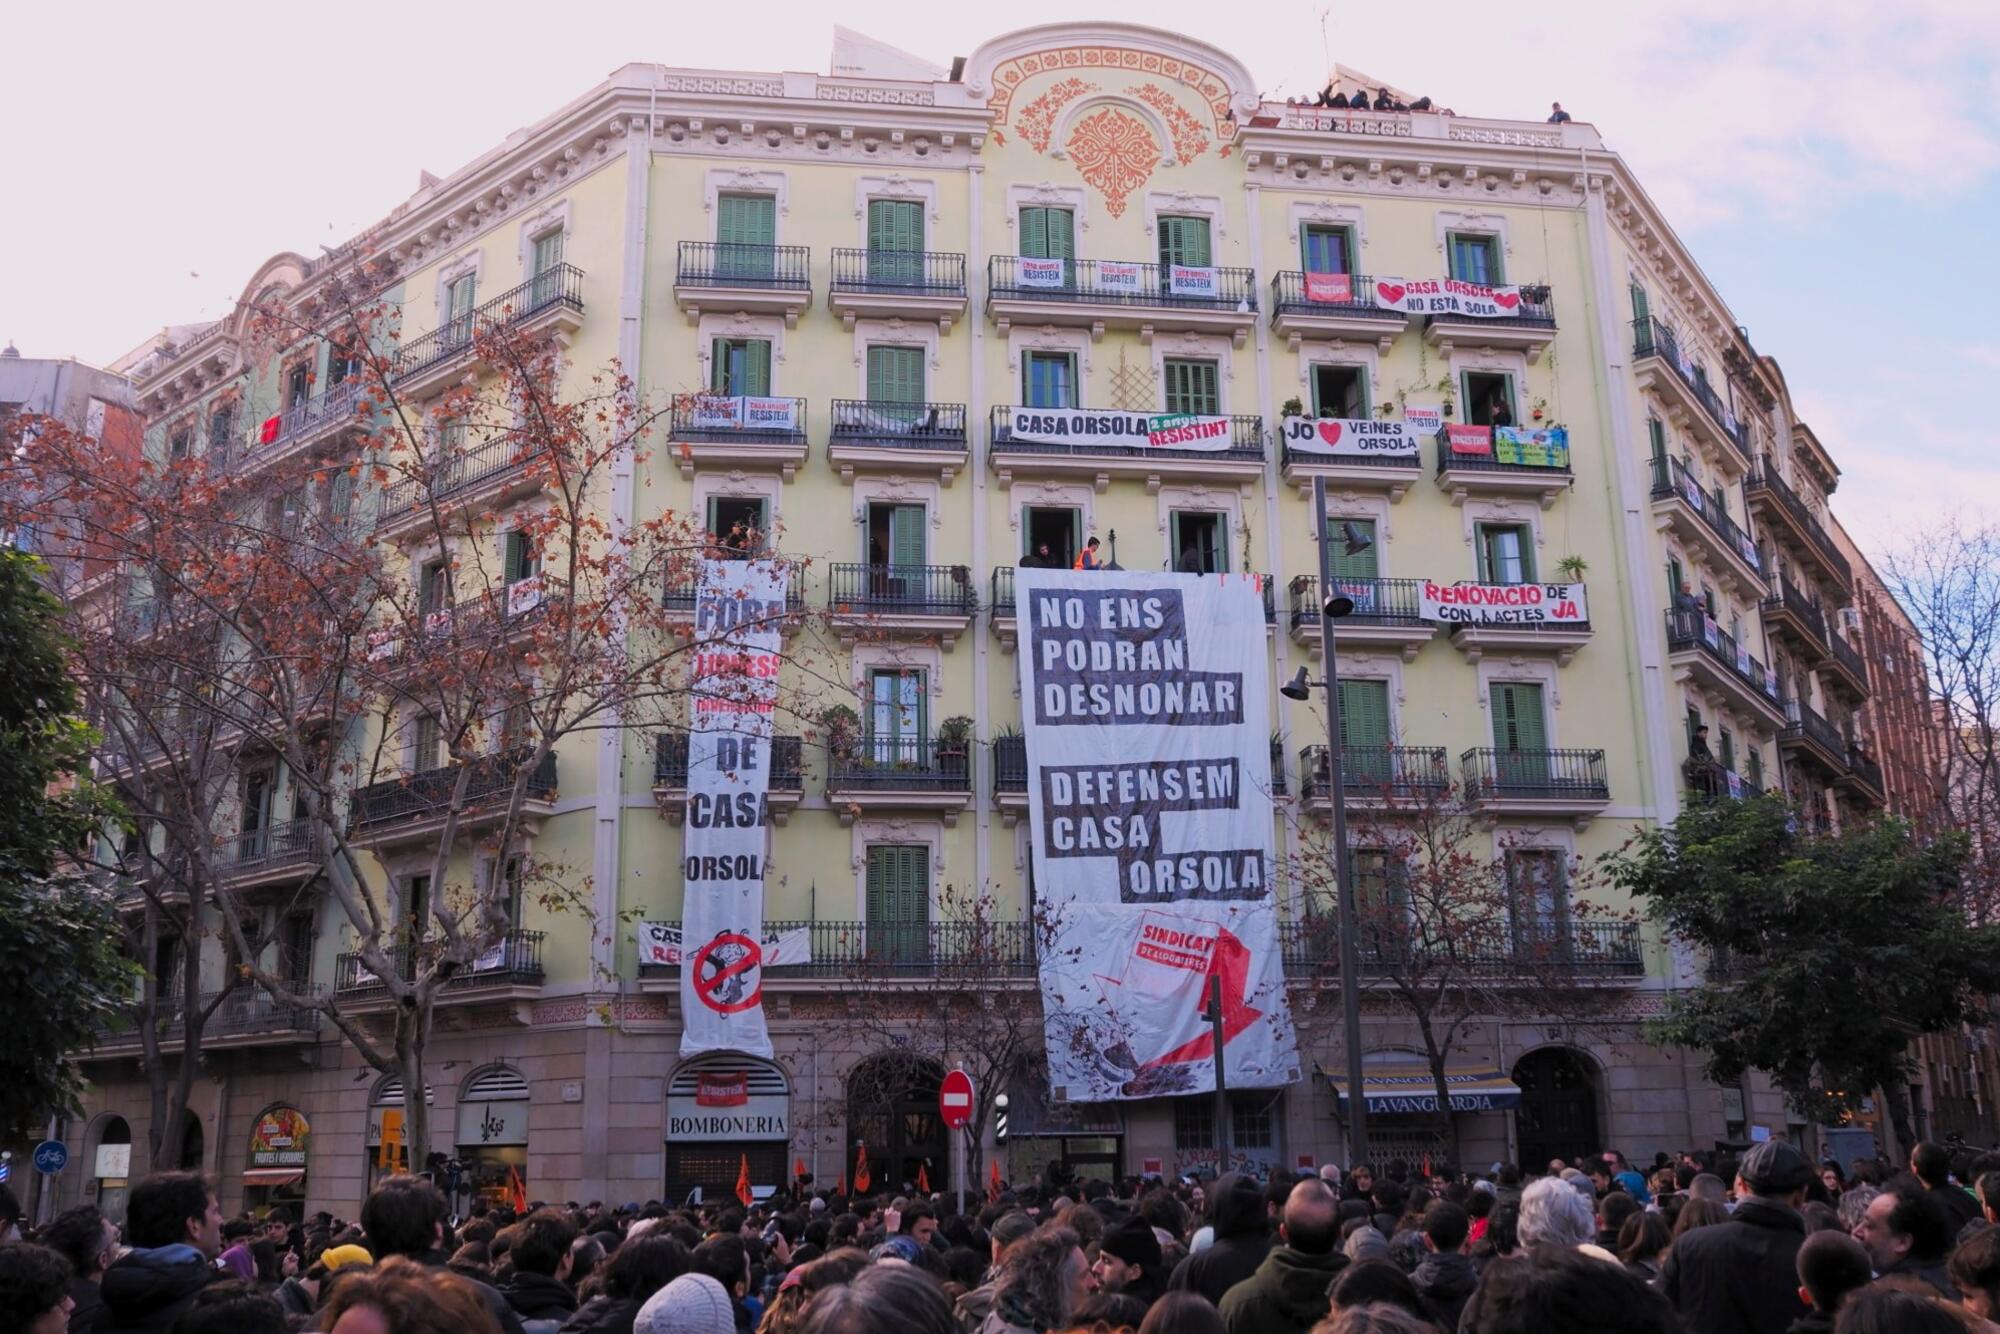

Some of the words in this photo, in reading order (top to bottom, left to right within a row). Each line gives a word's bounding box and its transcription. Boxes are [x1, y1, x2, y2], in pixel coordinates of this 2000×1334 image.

[1023, 270, 1061, 281] RESISTEIX
[1101, 273, 1137, 285] RESISTEIX
[1175, 277, 1212, 289] RESISTEIX
[1406, 282, 1440, 293] CASA
[1407, 298, 1425, 311] NO
[1466, 304, 1498, 315] SOLA
[749, 409, 788, 421] RESISTEIX
[1016, 414, 1069, 436] CASA
[1071, 416, 1149, 436] ORSOLA
[1150, 420, 1159, 429] 2
[1163, 415, 1197, 428] anys
[1149, 420, 1228, 447] RESISTINT
[1287, 422, 1314, 440] JO
[1350, 421, 1402, 435] VEINES
[1358, 437, 1417, 451] ORSOLA
[1425, 581, 1541, 606] RENOVACIO
[1547, 586, 1568, 599] DE
[1040, 598, 1084, 629] NO
[1100, 598, 1163, 629] ENS
[1552, 601, 1579, 619] JA
[1042, 639, 1184, 671] PODRAN
[1044, 681, 1235, 716] DESNONAR
[717, 737, 757, 771] DE
[1050, 765, 1233, 805] DEFENSEM
[1052, 814, 1149, 850] CASA
[686, 855, 764, 881] ORSOL
[1130, 856, 1260, 894] ORSOLA
[1143, 925, 1214, 952] SINDICAT
[671, 1117, 785, 1134] BOMBONERIA
